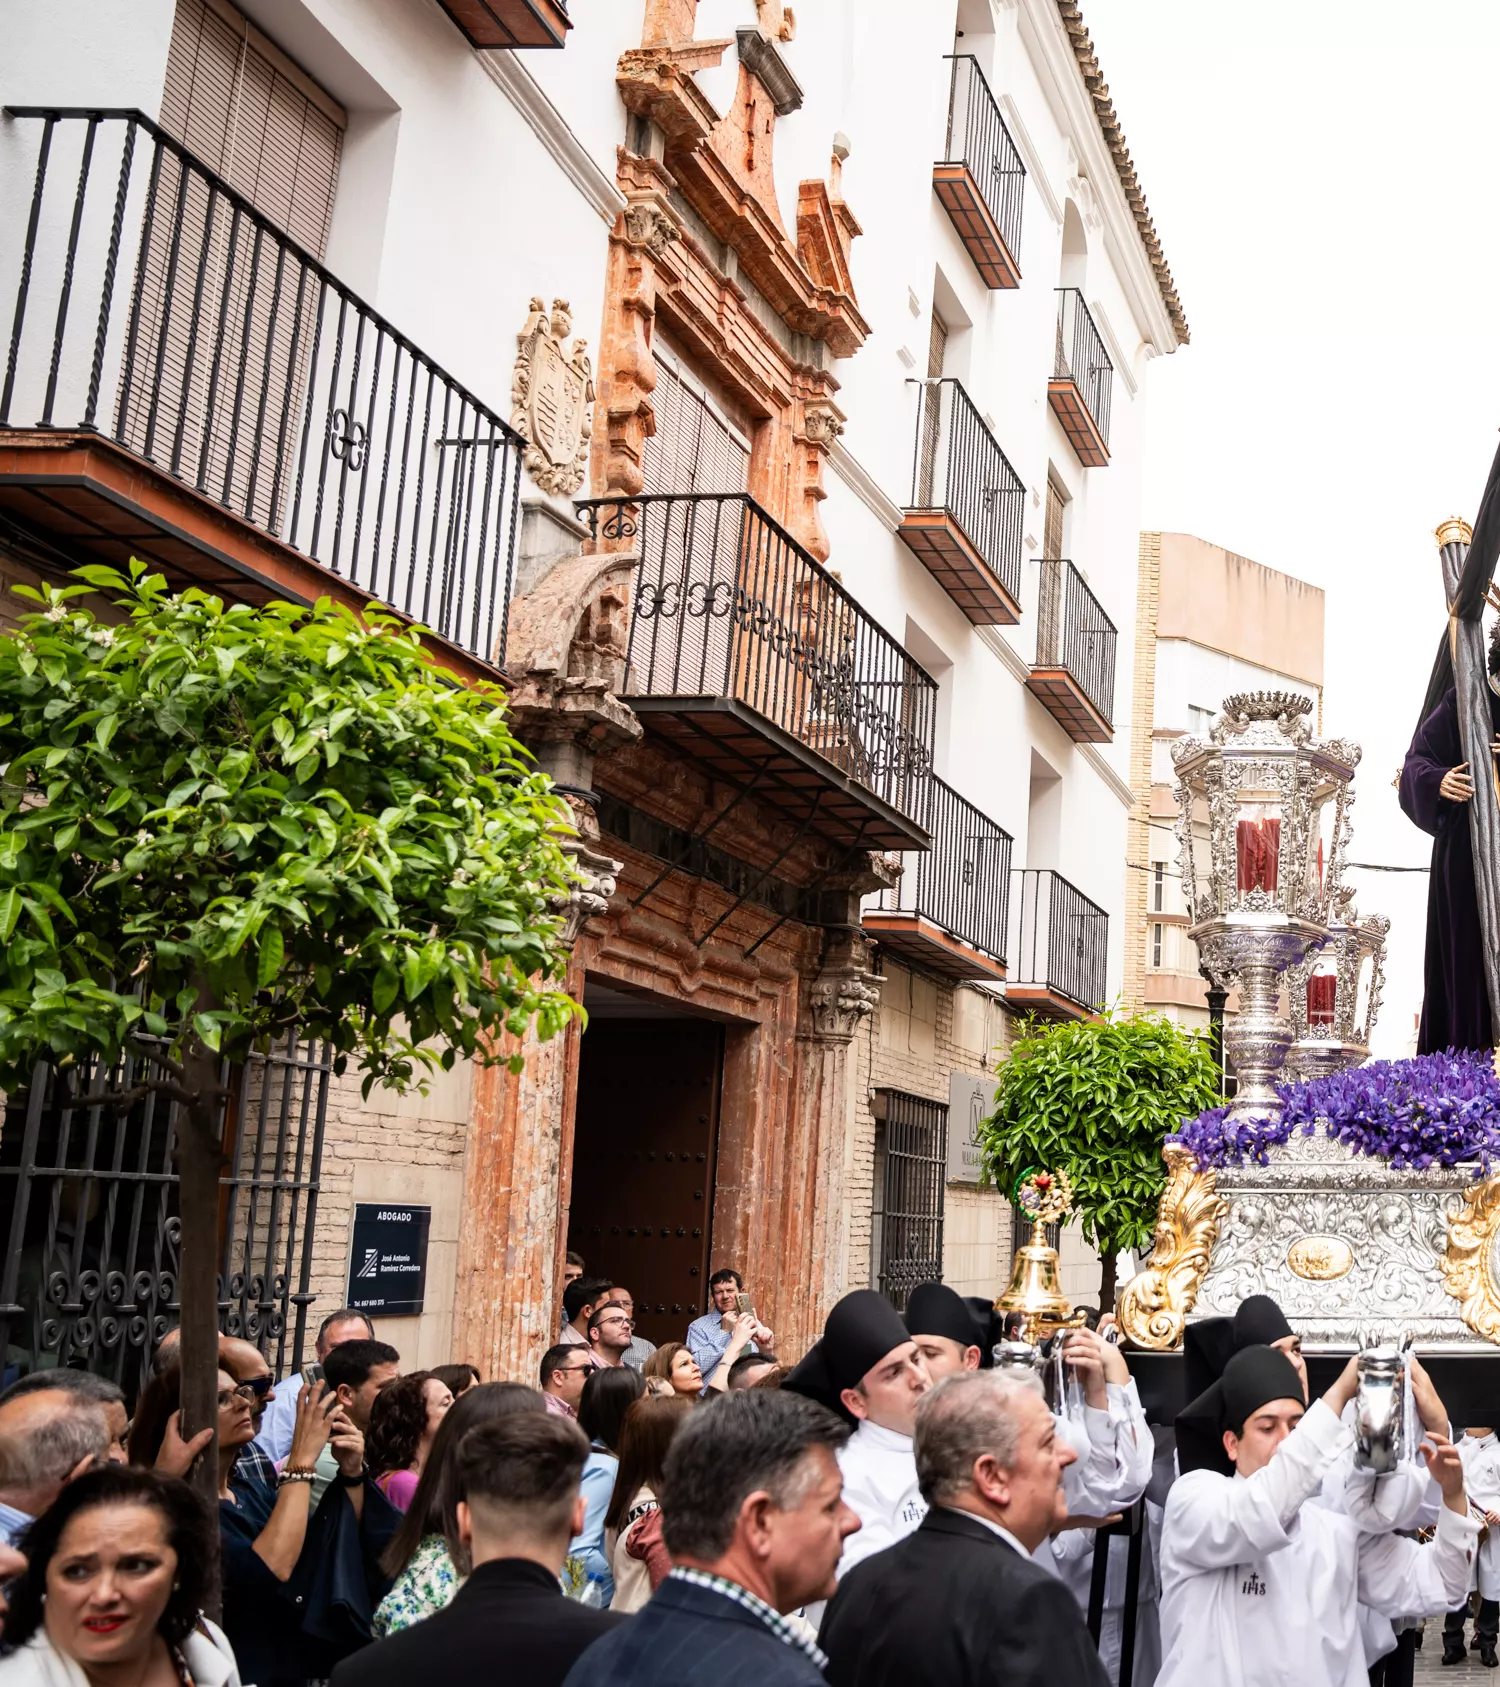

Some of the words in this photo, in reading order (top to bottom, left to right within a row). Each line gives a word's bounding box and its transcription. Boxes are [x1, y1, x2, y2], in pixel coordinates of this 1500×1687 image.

[377, 1211, 412, 1222] ABOGADO
[381, 1254, 392, 1262] José
[393, 1254, 410, 1262] Antonio
[399, 1264, 421, 1272] Corredera
[1242, 1575, 1266, 1596] IHS
